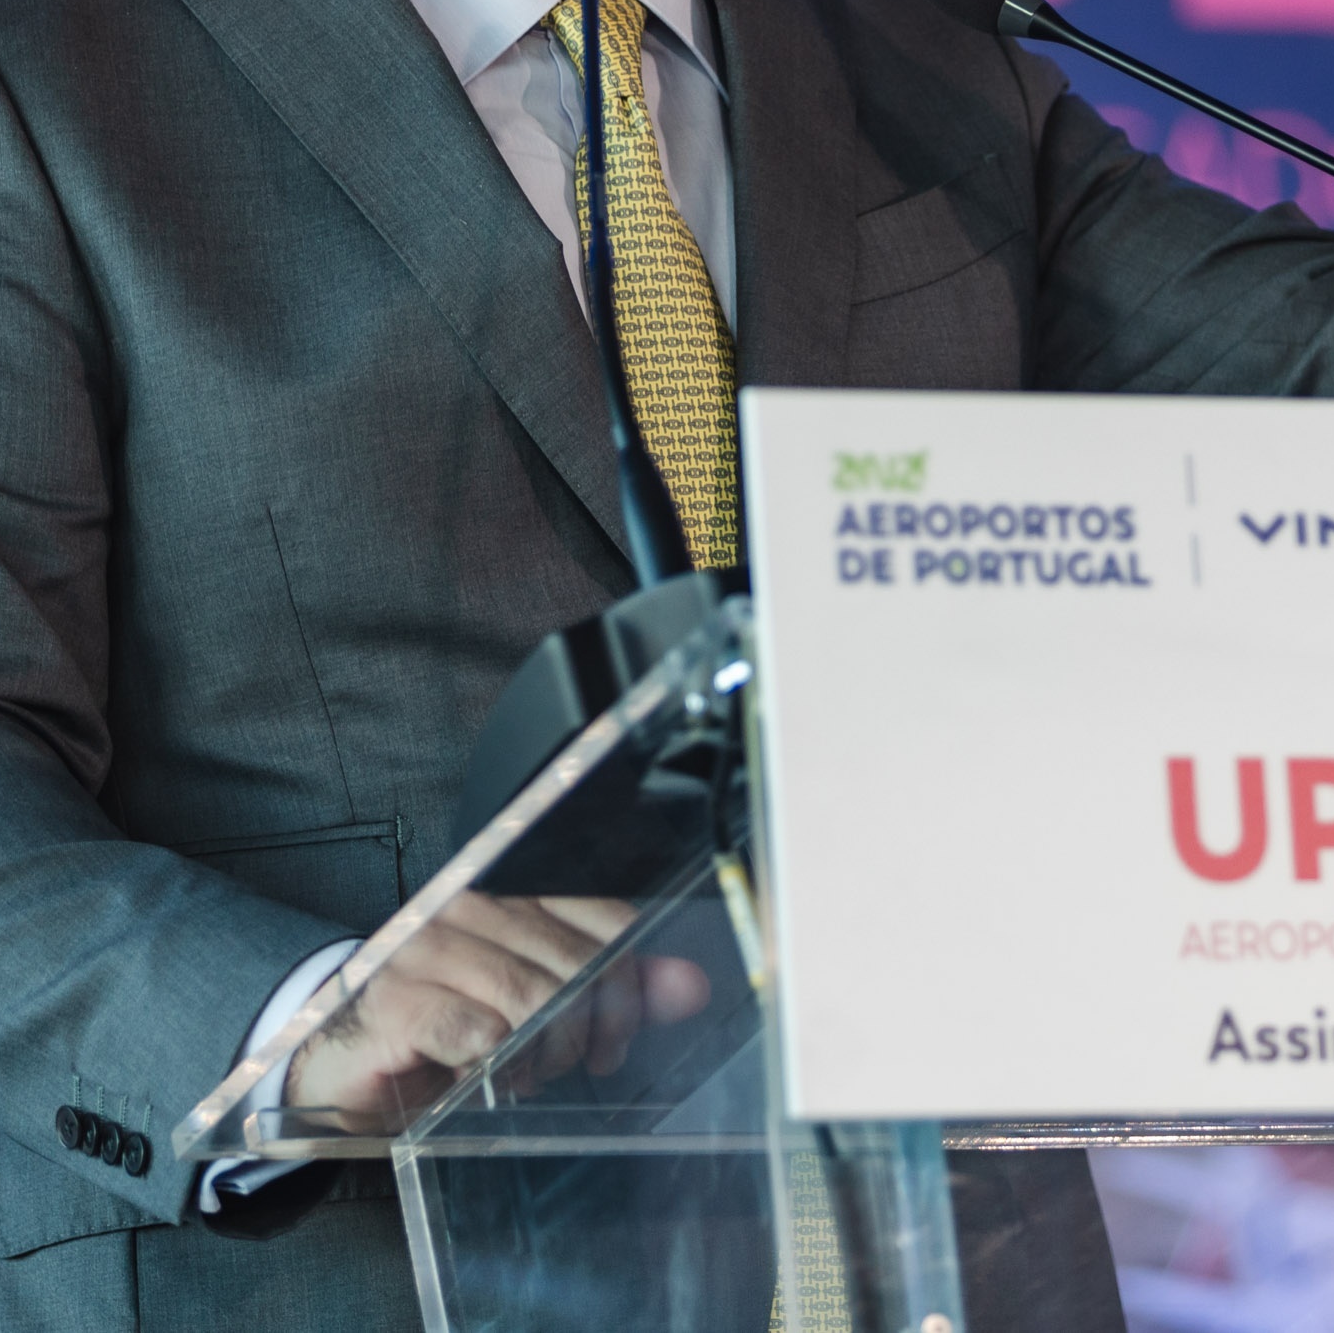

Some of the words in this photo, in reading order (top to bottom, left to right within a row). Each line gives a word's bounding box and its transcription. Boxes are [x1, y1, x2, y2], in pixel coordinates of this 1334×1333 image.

[836, 503, 1137, 541] AEROPORTOS
[837, 547, 894, 585] DE
[914, 548, 1152, 587] PORTUGAL
